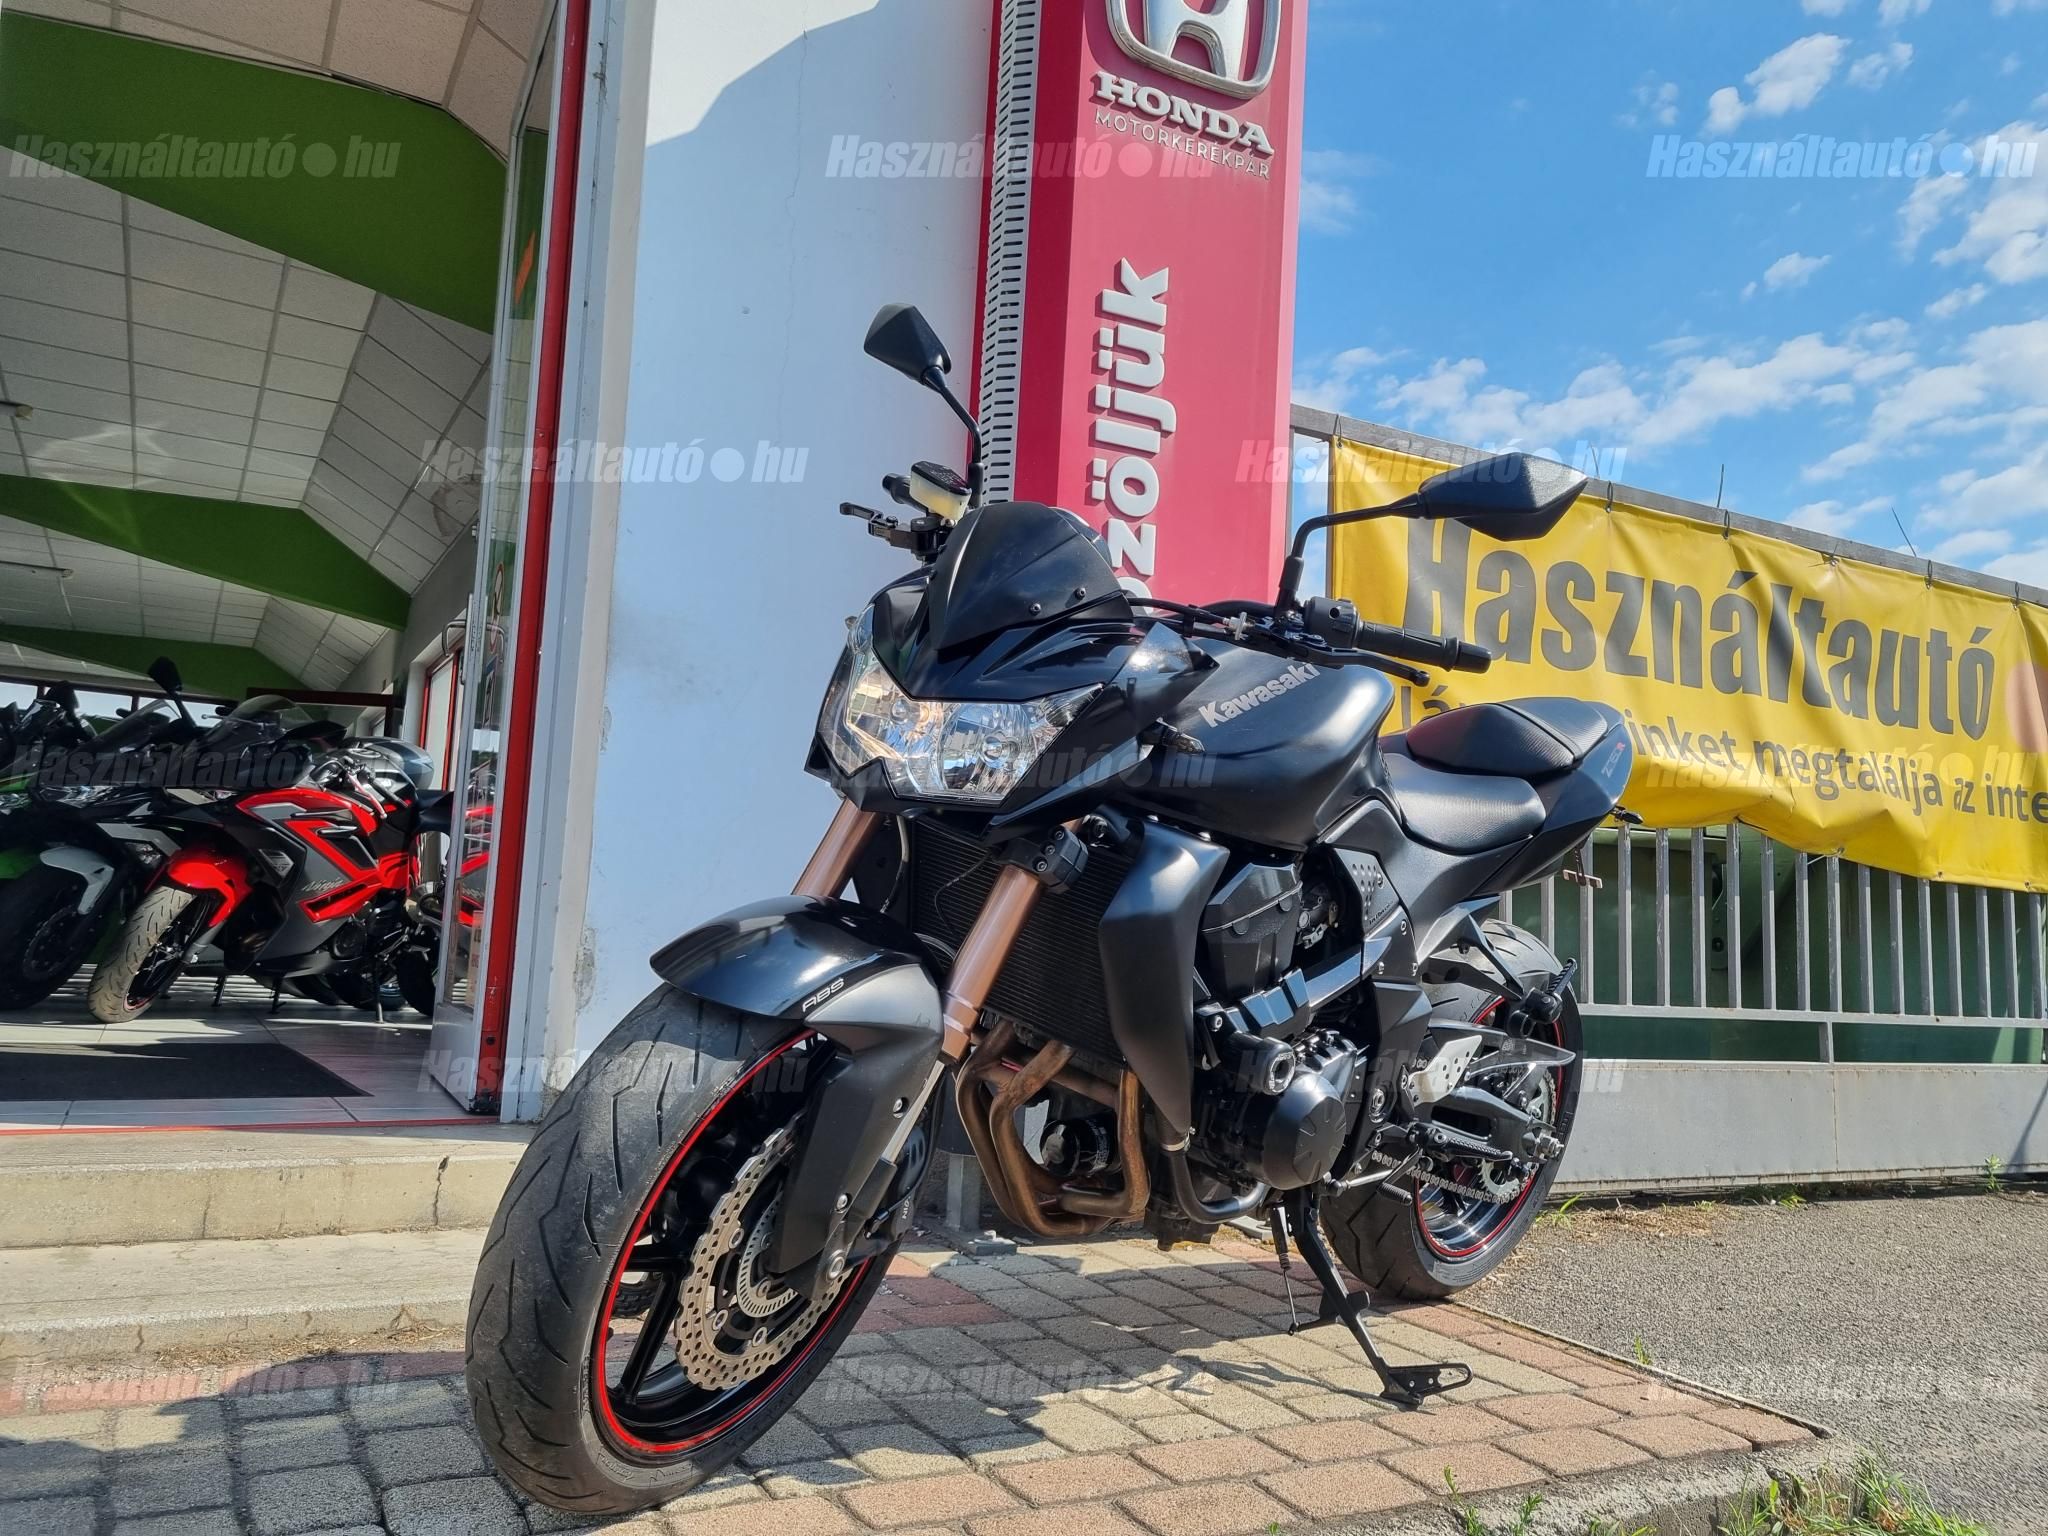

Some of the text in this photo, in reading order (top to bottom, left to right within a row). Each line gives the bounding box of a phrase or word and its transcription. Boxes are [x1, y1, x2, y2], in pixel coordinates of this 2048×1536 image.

[1095, 108, 1270, 180] MOTORKERÉKPÁR
[1096, 71, 1275, 155] HONDA
[1403, 515, 1996, 740] Használtautó
[1198, 660, 1321, 728] Kawasaki
[1752, 739, 1943, 817] megtalálja
[1953, 777, 1976, 814] az
[1984, 772, 2048, 824] inte
[802, 976, 845, 1013] ABS
